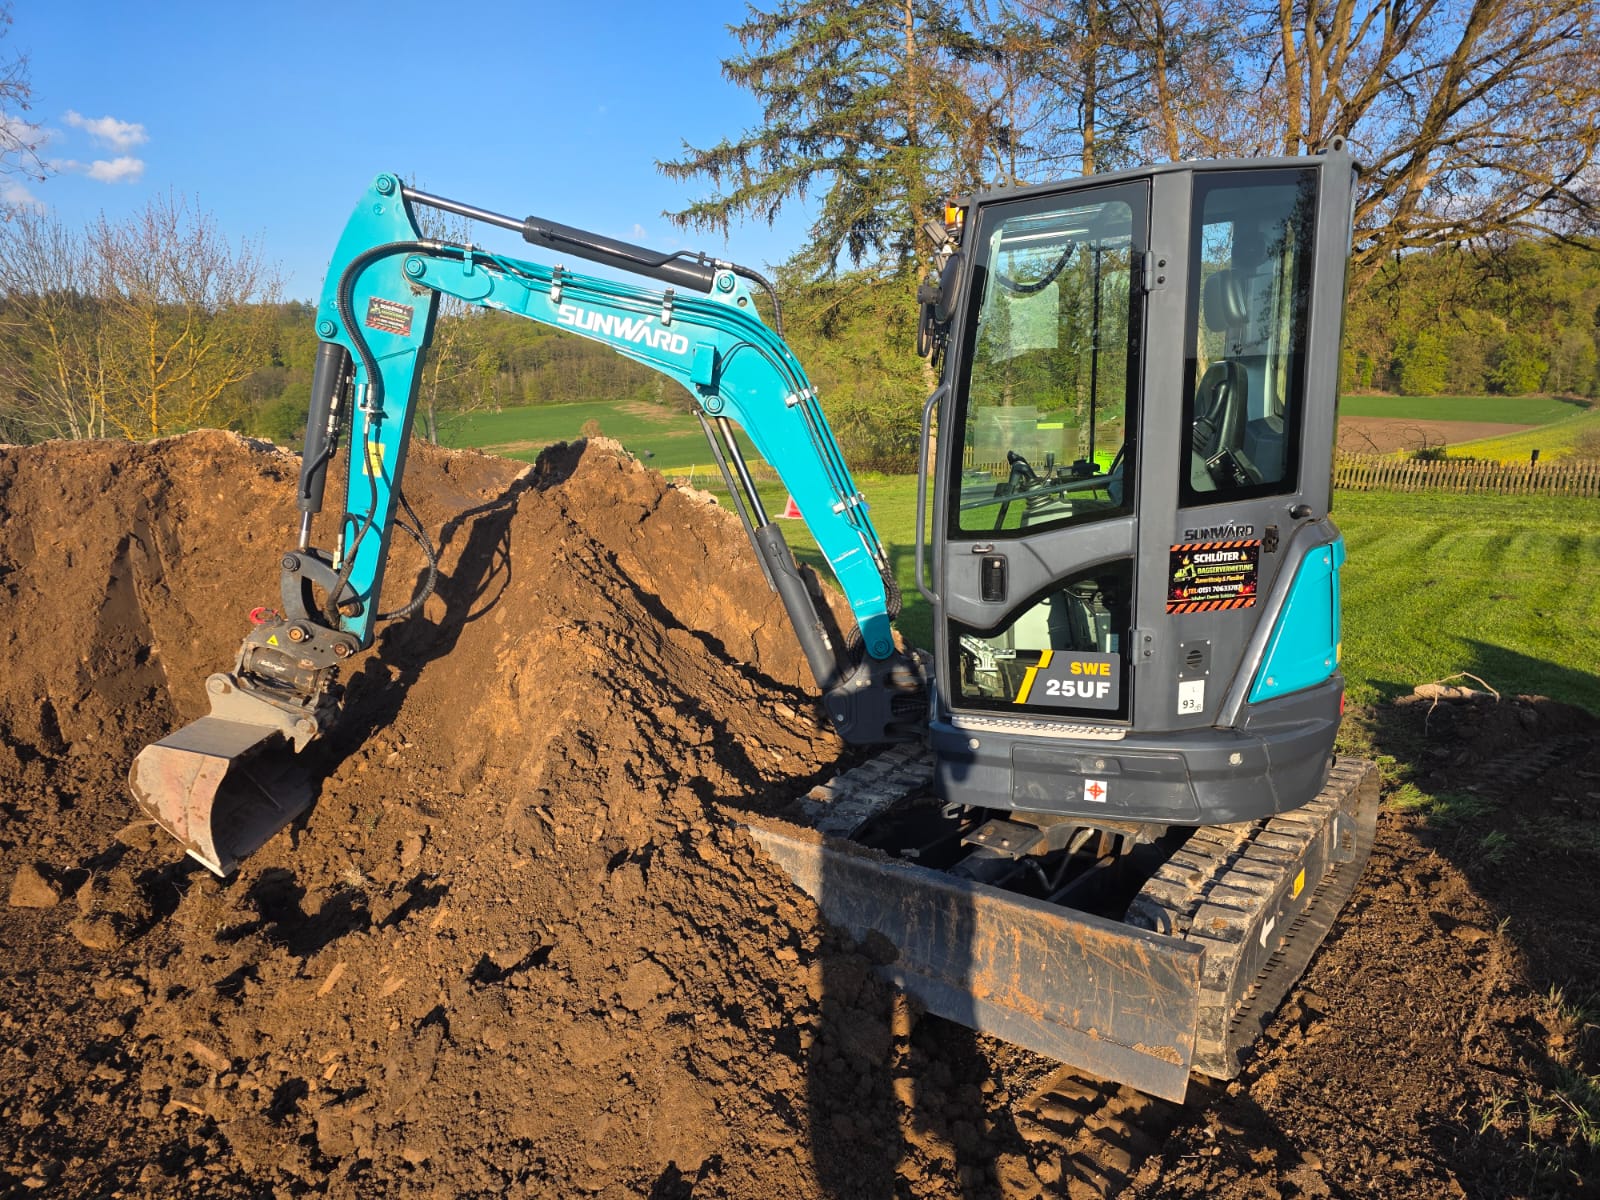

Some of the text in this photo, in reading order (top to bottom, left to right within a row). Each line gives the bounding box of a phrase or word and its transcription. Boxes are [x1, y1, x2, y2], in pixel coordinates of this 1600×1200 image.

[557, 303, 689, 355] SUNWARD
[1185, 520, 1254, 540] SUNWARD
[1194, 551, 1239, 563] SCHLÜTER
[1070, 661, 1111, 677] SWE
[1046, 679, 1111, 699] 25UF
[1182, 699, 1195, 709] 93
